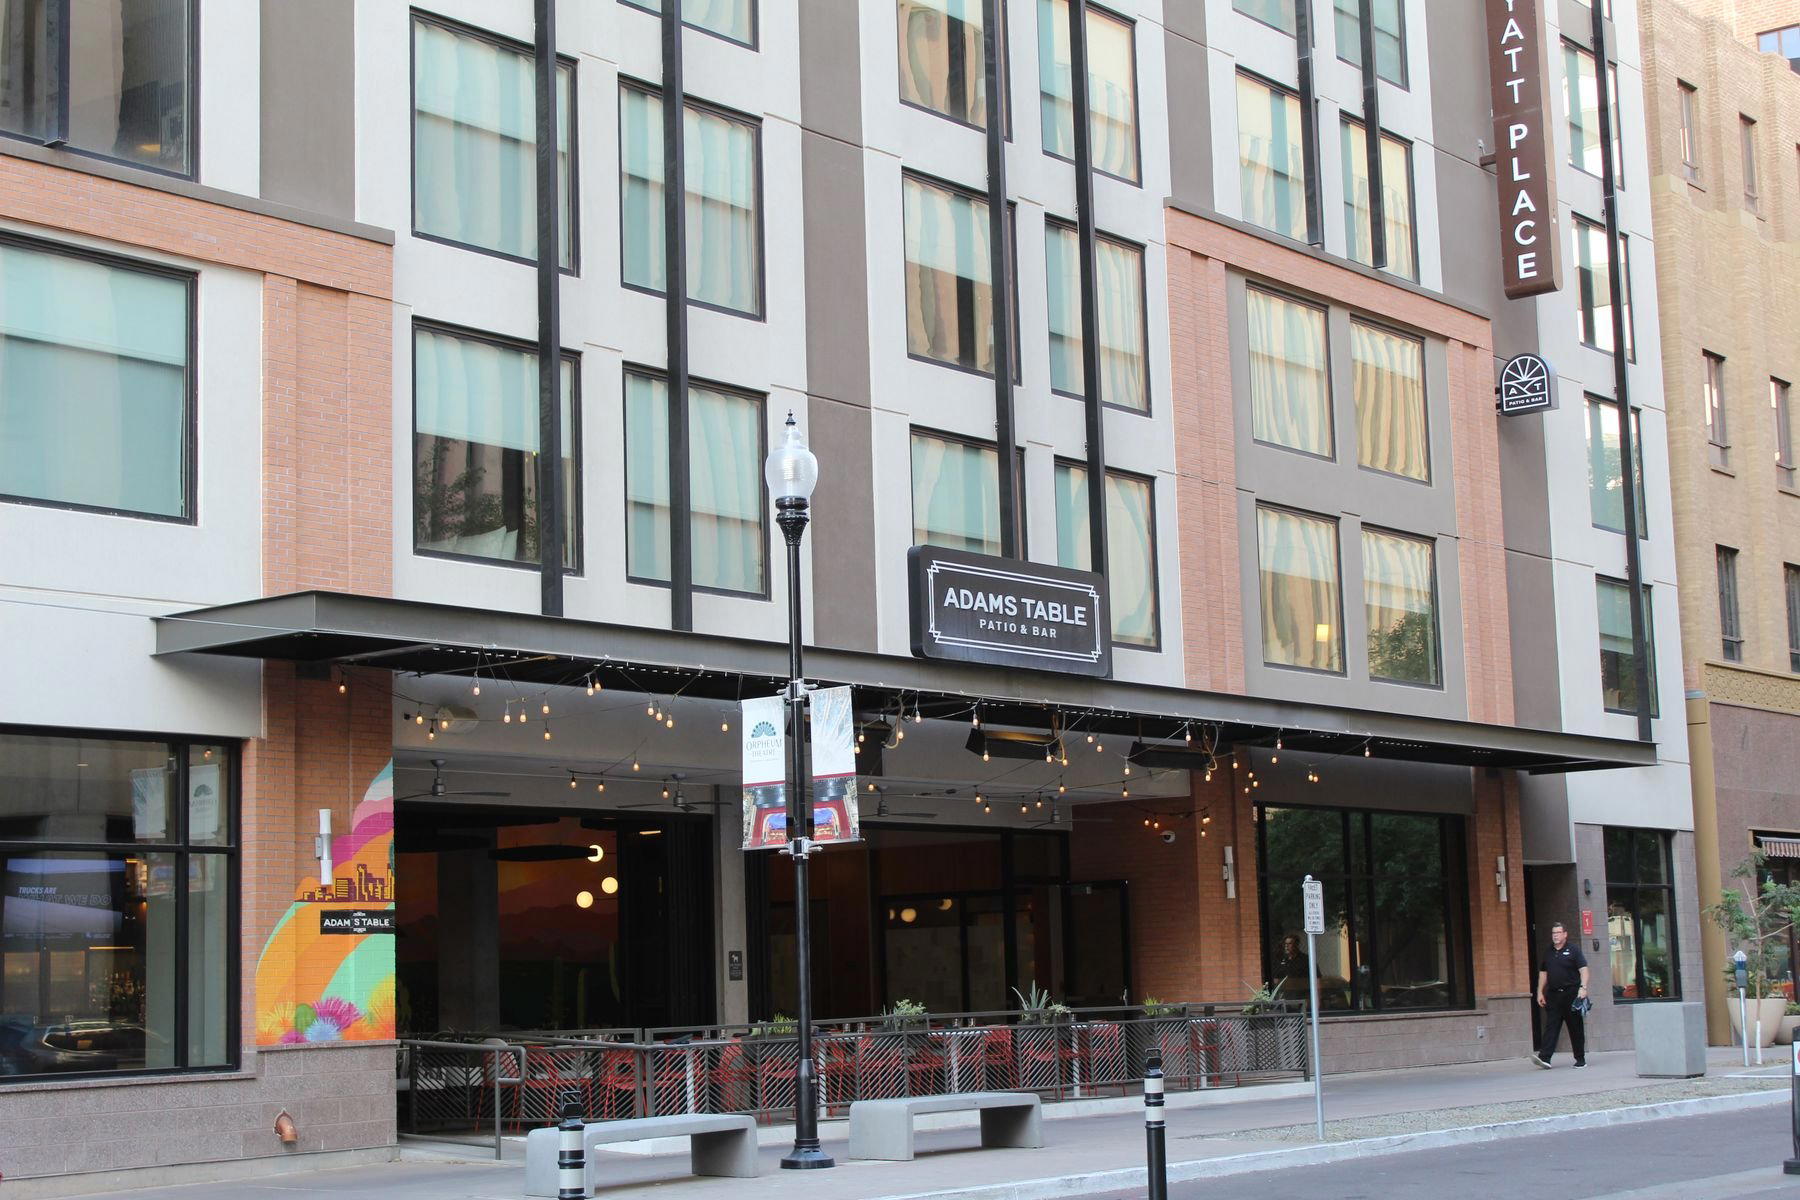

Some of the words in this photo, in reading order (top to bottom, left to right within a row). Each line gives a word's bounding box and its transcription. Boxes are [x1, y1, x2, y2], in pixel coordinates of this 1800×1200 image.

[1509, 123, 1538, 280] PLACE
[943, 587, 1018, 617] ADAMS
[1020, 597, 1088, 626] TABLE
[979, 618, 1017, 633] PATIO
[1020, 624, 1028, 635] &
[1032, 626, 1057, 639] BAR
[746, 738, 782, 751] ORPHEUM
[19, 886, 43, 895] TRUCKS
[89, 894, 112, 906] DO
[361, 918, 390, 926] TABLE
